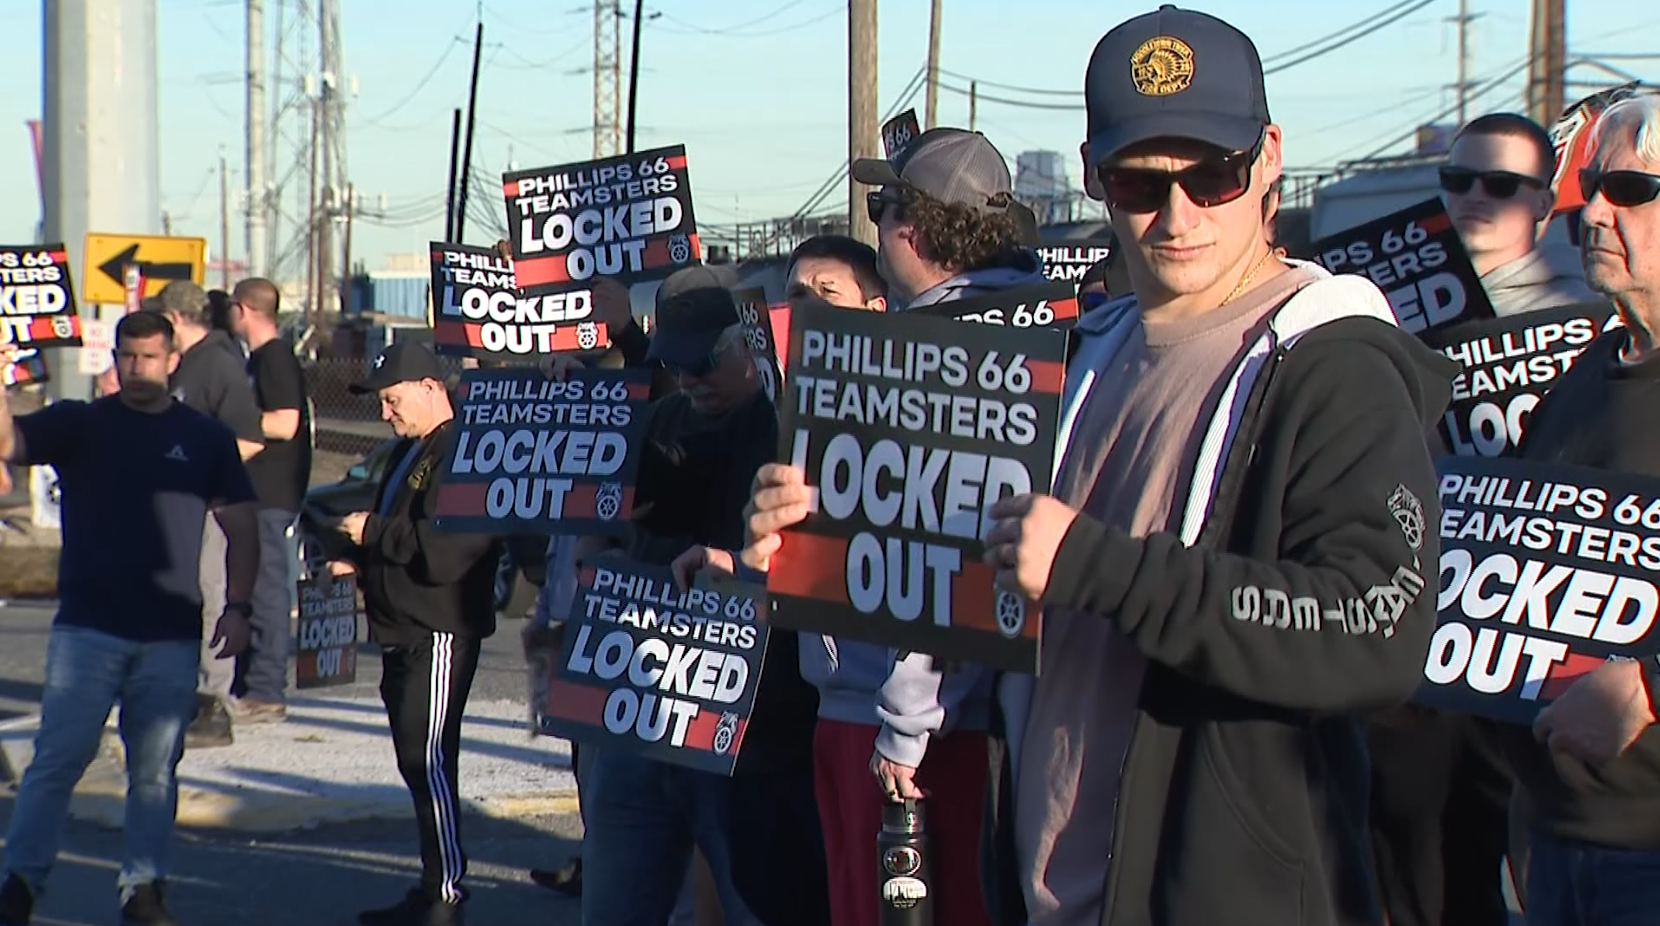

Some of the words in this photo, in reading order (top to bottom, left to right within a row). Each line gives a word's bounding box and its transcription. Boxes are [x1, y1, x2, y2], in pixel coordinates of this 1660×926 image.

[516, 174, 678, 216] TEAMSTERS
[517, 164, 633, 197] PHILLIPS
[639, 156, 670, 176] 66
[521, 196, 683, 253] LOCKED
[1314, 241, 1374, 272] PS
[1381, 221, 1428, 253] 66
[22, 251, 53, 267] 66
[566, 239, 646, 280] OUT
[1360, 242, 1448, 287] ERS
[442, 284, 593, 324] LOCKED
[1012, 300, 1054, 328] 66
[480, 321, 556, 353] OUT
[1436, 318, 1594, 367] HILLIPS
[802, 330, 969, 387] PHILLIPS
[976, 351, 1032, 394] 66
[469, 380, 584, 401] PHILLIPS
[590, 380, 629, 401] 66
[795, 375, 1038, 446] TEAMSTERS
[462, 403, 633, 426] TEAMSTERS
[451, 429, 628, 475] LOCKED
[486, 477, 573, 520] OUT
[1439, 474, 1608, 520] PHILLIPS
[592, 568, 721, 614] PHILLIPS
[724, 595, 757, 621] 66
[846, 531, 963, 628] OUT
[301, 615, 355, 650] LOCKED
[584, 593, 757, 649] TEAMSTERS
[317, 647, 342, 678] OUT
[566, 624, 749, 704] LOCKED
[1423, 621, 1569, 701] OUT
[603, 687, 699, 748] OUT
